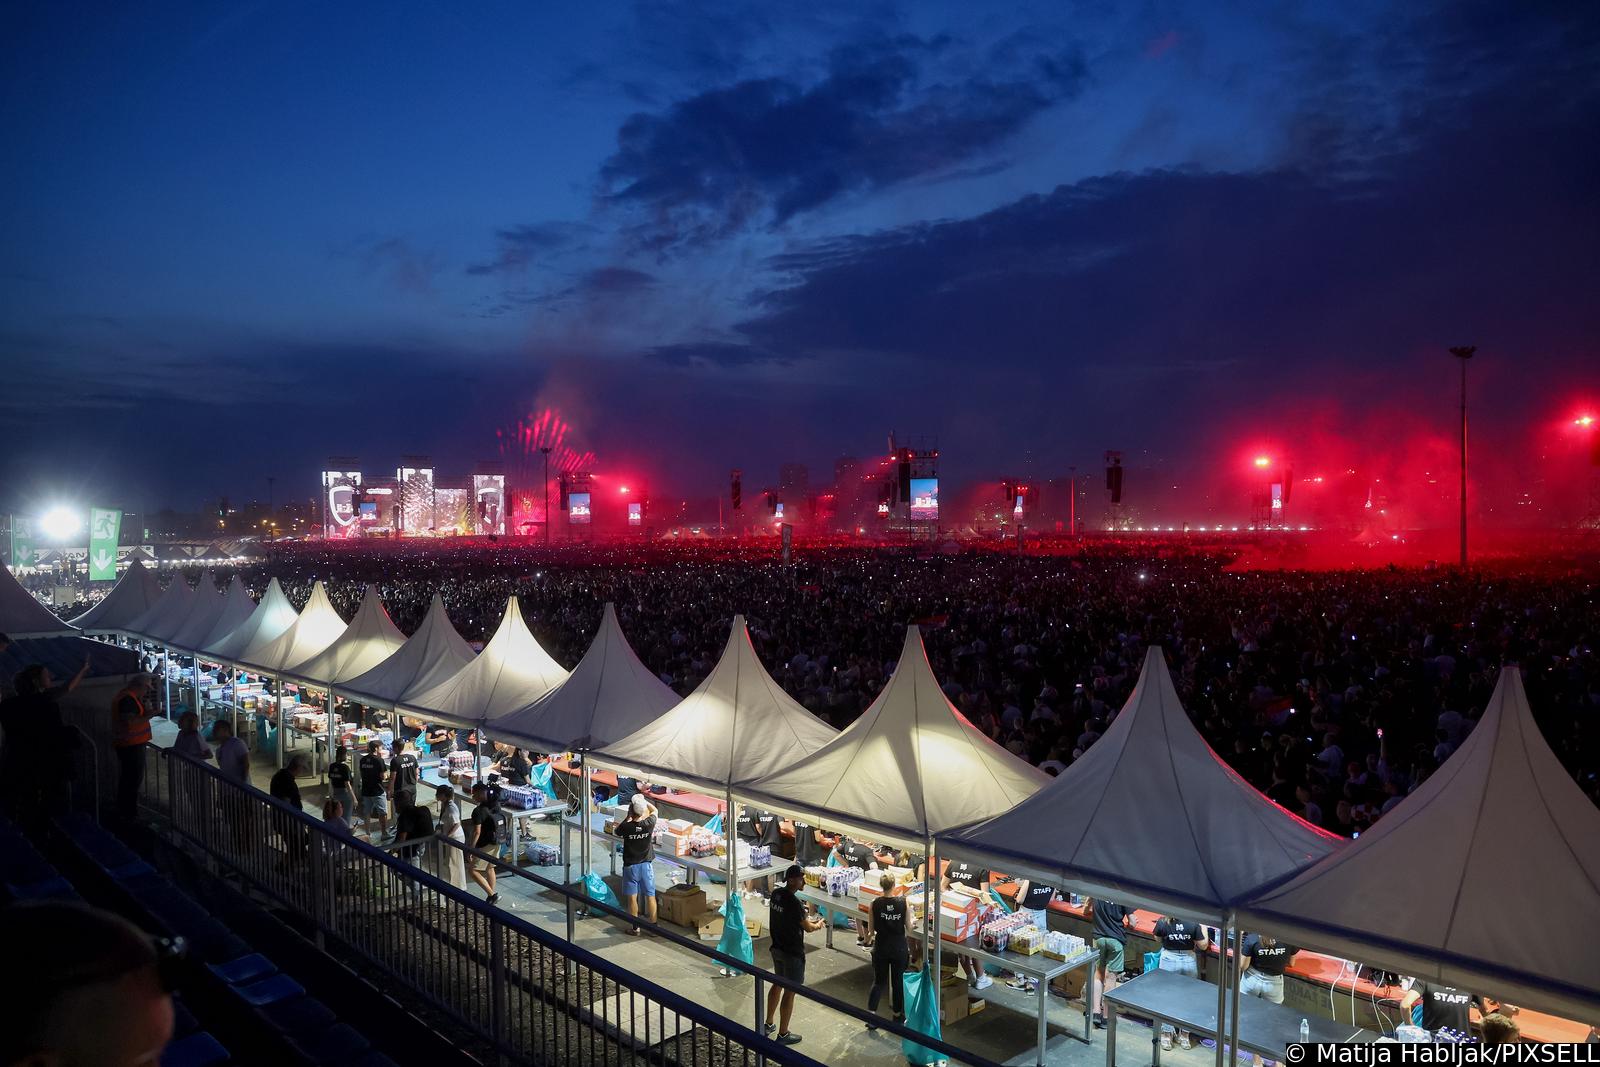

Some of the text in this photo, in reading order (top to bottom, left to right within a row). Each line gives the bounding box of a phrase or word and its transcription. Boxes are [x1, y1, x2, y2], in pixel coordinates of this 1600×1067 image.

[627, 832, 650, 840] STAFF
[952, 871, 973, 880] STAFF
[1258, 948, 1286, 956] STAFF
[1433, 991, 1469, 1004] STAFF
